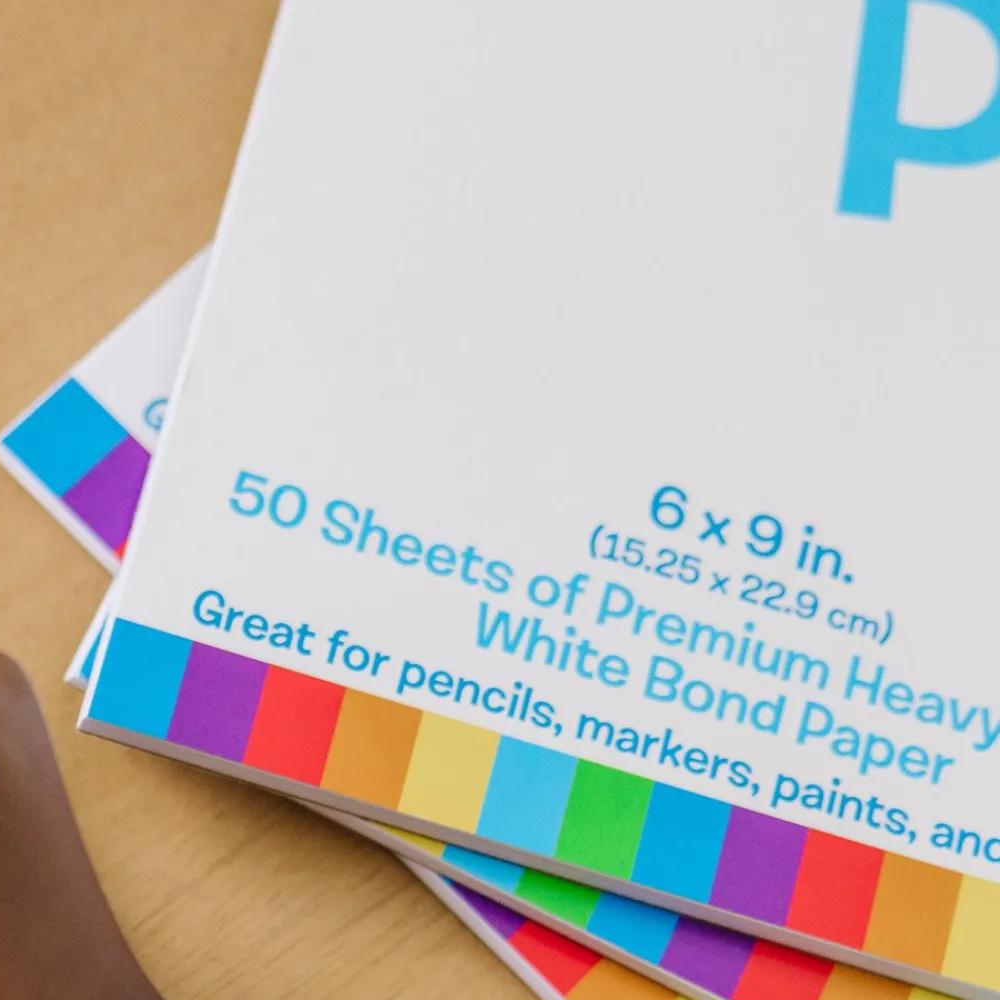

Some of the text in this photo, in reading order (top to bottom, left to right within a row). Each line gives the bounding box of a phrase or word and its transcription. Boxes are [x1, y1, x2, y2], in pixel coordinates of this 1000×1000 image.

[228, 469, 308, 529] 50
[319, 499, 514, 595] Sheets
[527, 573, 590, 617] of
[596, 580, 831, 692] Premium
[588, 524, 895, 645] (15.25 x 22.9 cm)
[650, 485, 854, 584] 6 x 9 in.
[192, 589, 316, 656] Great
[327, 630, 390, 678] for
[396, 658, 564, 737] pencils,
[575, 712, 761, 797] markers,
[770, 770, 918, 845] paints,
[476, 601, 955, 786] White Bond Paper
